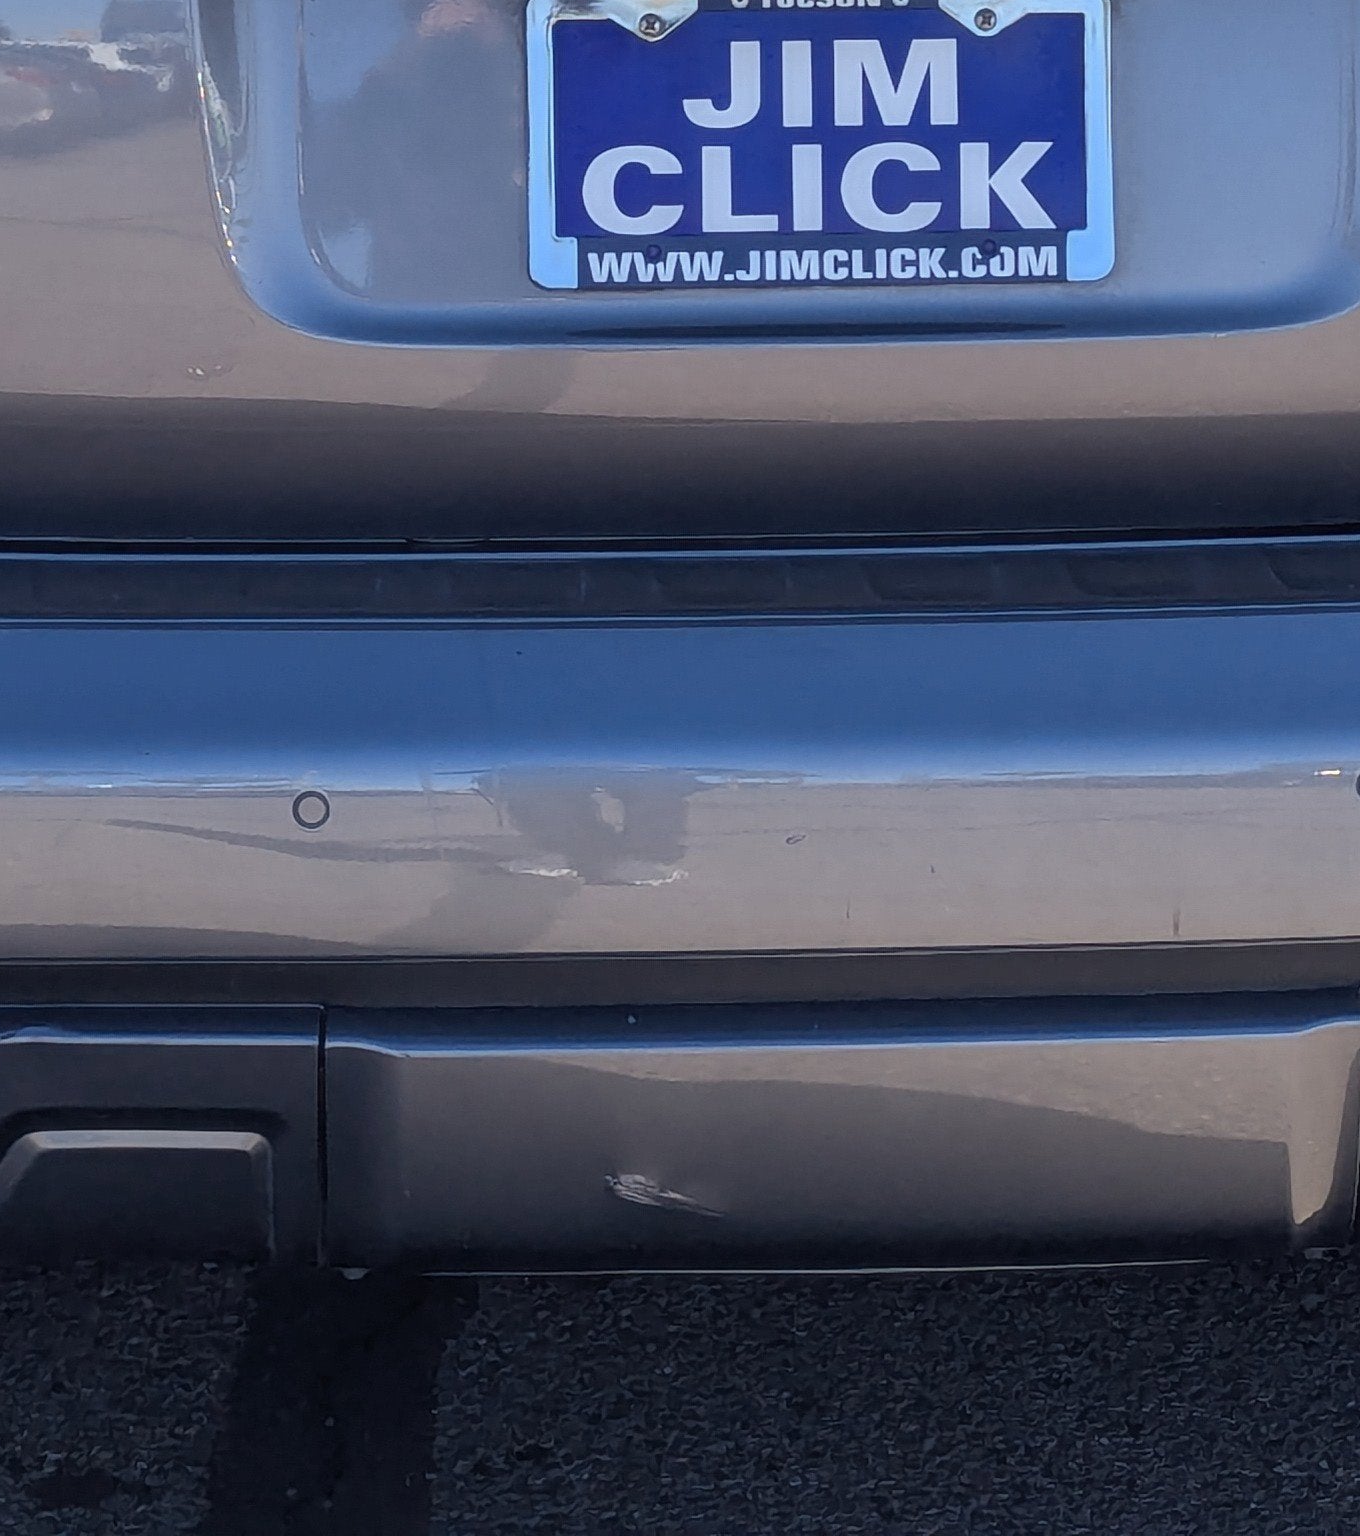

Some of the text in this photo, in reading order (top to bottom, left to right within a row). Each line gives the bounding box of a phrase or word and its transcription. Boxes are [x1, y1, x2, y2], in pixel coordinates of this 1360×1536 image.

[681, 37, 960, 130] JIM
[581, 140, 1058, 235] CLICK
[587, 245, 1058, 284] WWW.JIMCLICK.COM
